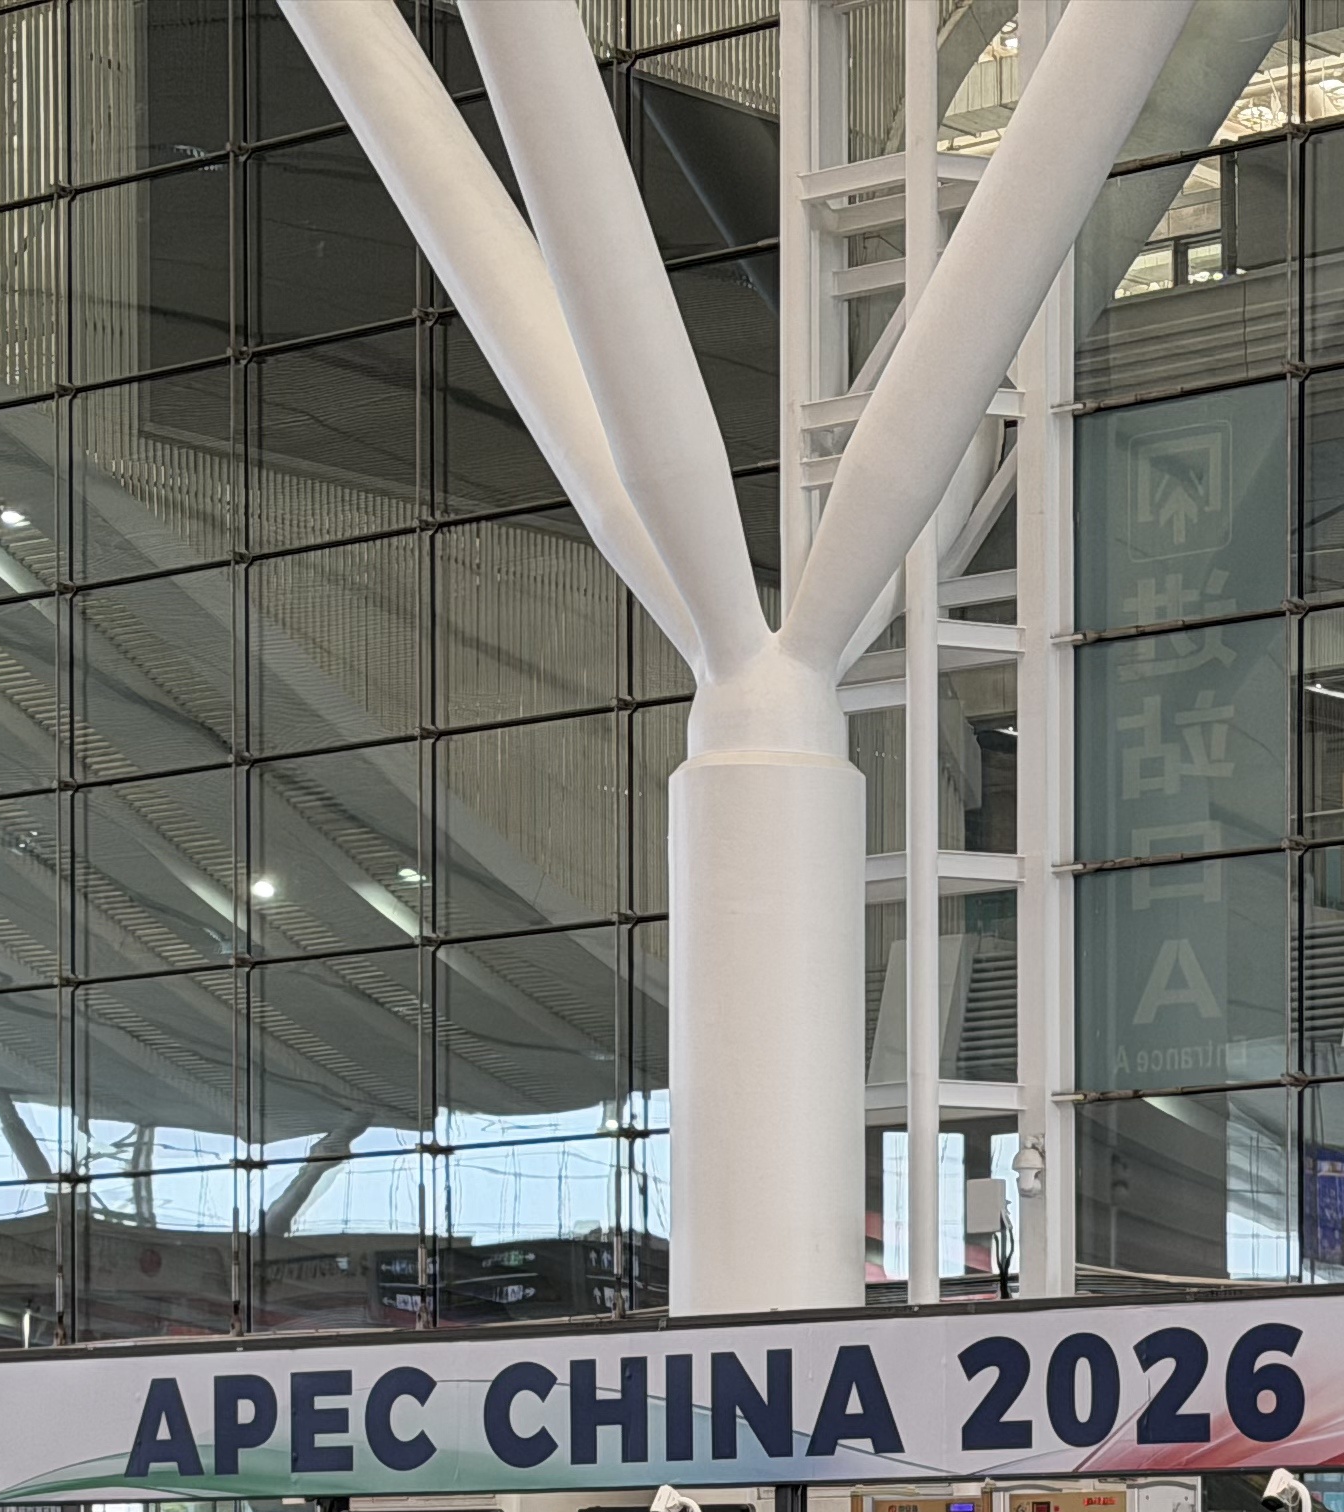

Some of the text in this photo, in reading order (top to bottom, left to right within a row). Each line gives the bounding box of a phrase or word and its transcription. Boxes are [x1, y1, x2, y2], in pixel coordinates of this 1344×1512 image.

[124, 1323, 1306, 1478] APEC CHINA 2026
